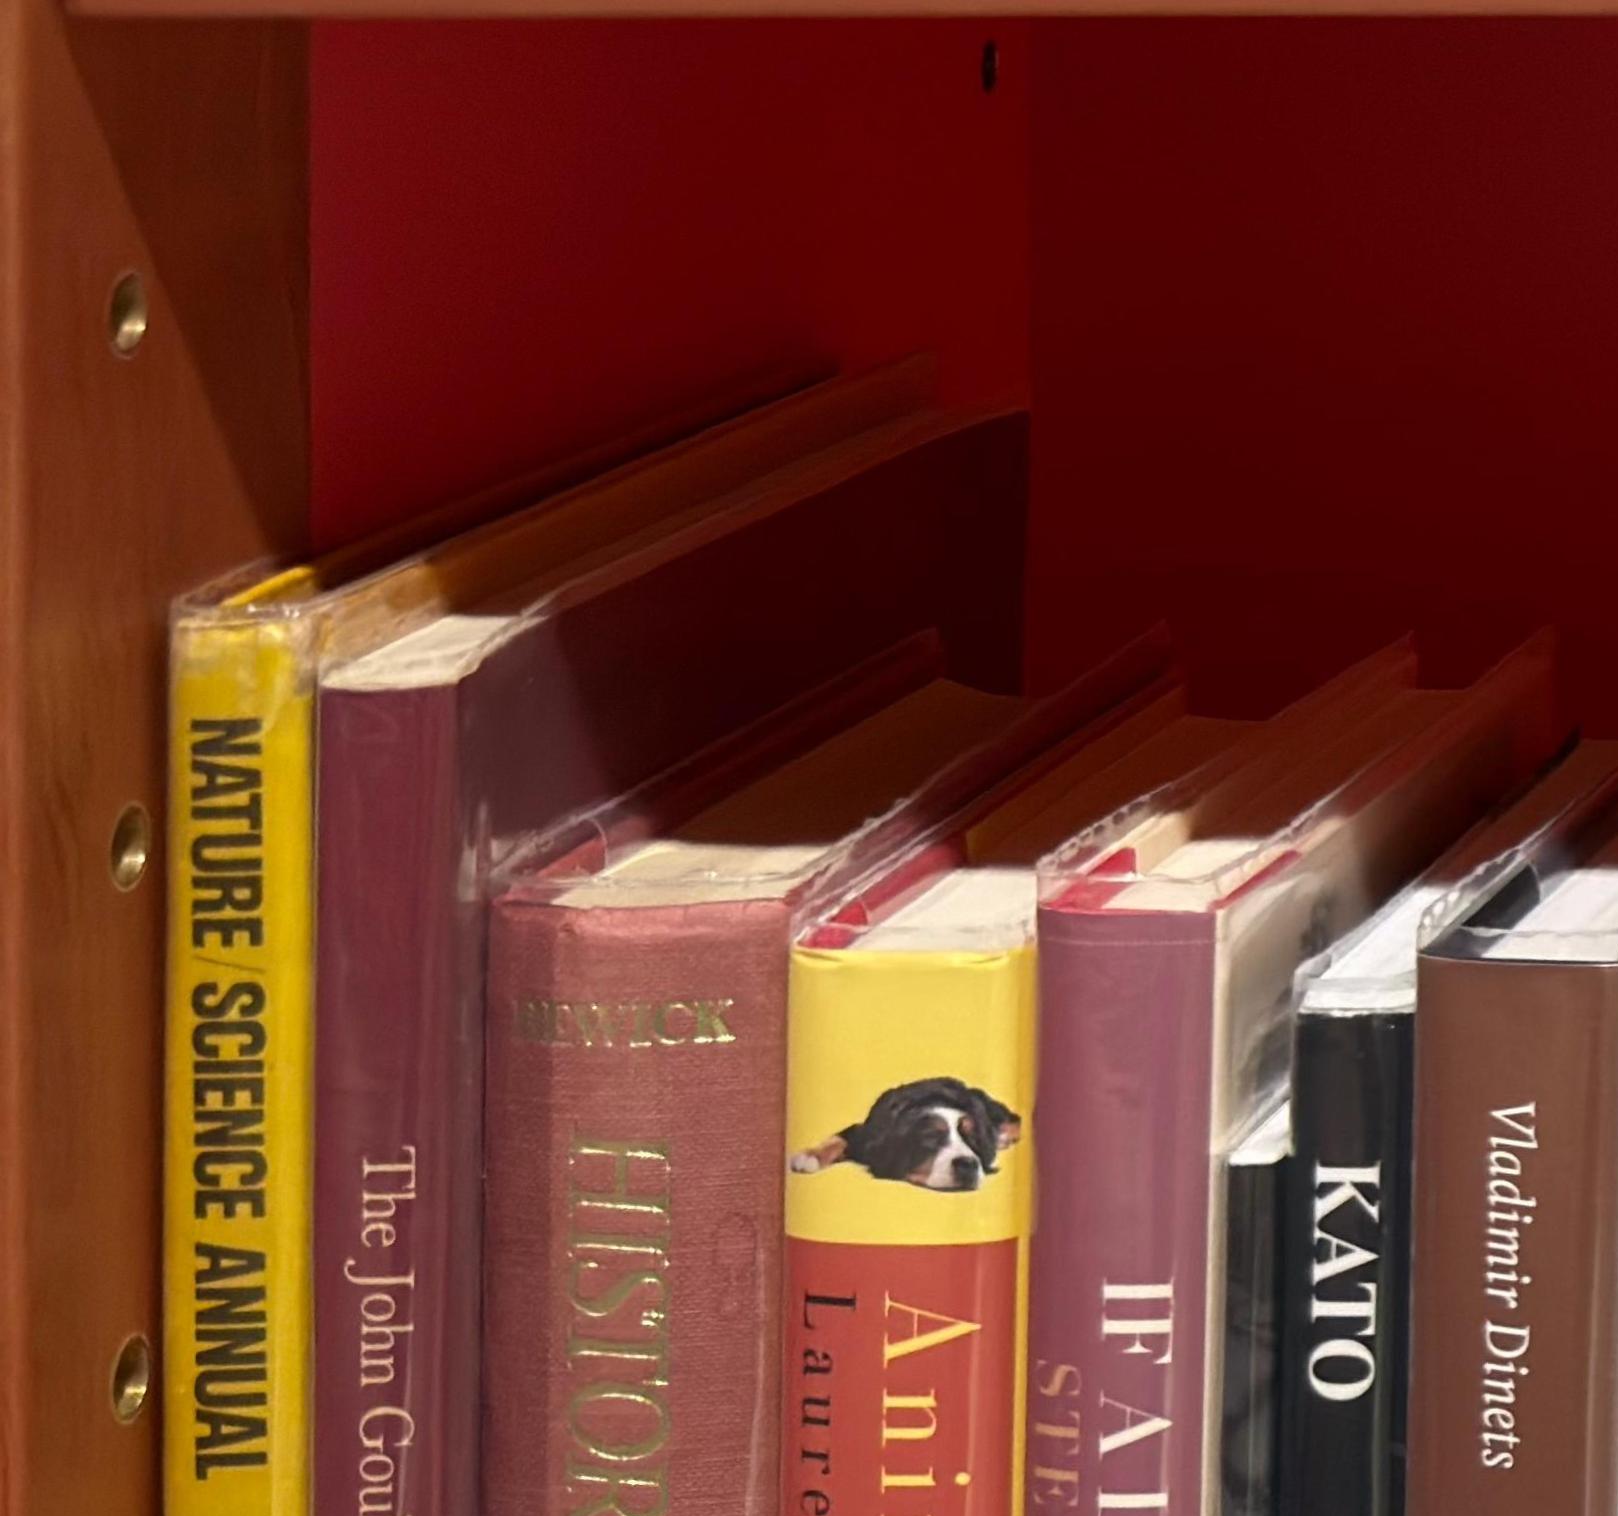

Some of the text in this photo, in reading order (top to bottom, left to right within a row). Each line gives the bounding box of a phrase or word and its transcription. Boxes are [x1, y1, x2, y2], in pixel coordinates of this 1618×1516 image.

[361, 1145, 416, 1249] The
[344, 1256, 415, 1387] John
[1102, 1277, 1174, 1365] IF
[1308, 1160, 1382, 1401] KATO
[1480, 1101, 1539, 1470] Vladimir Dinets
[194, 1243, 268, 1481] ANNUAL
[1100, 1389, 1174, 1460] A
